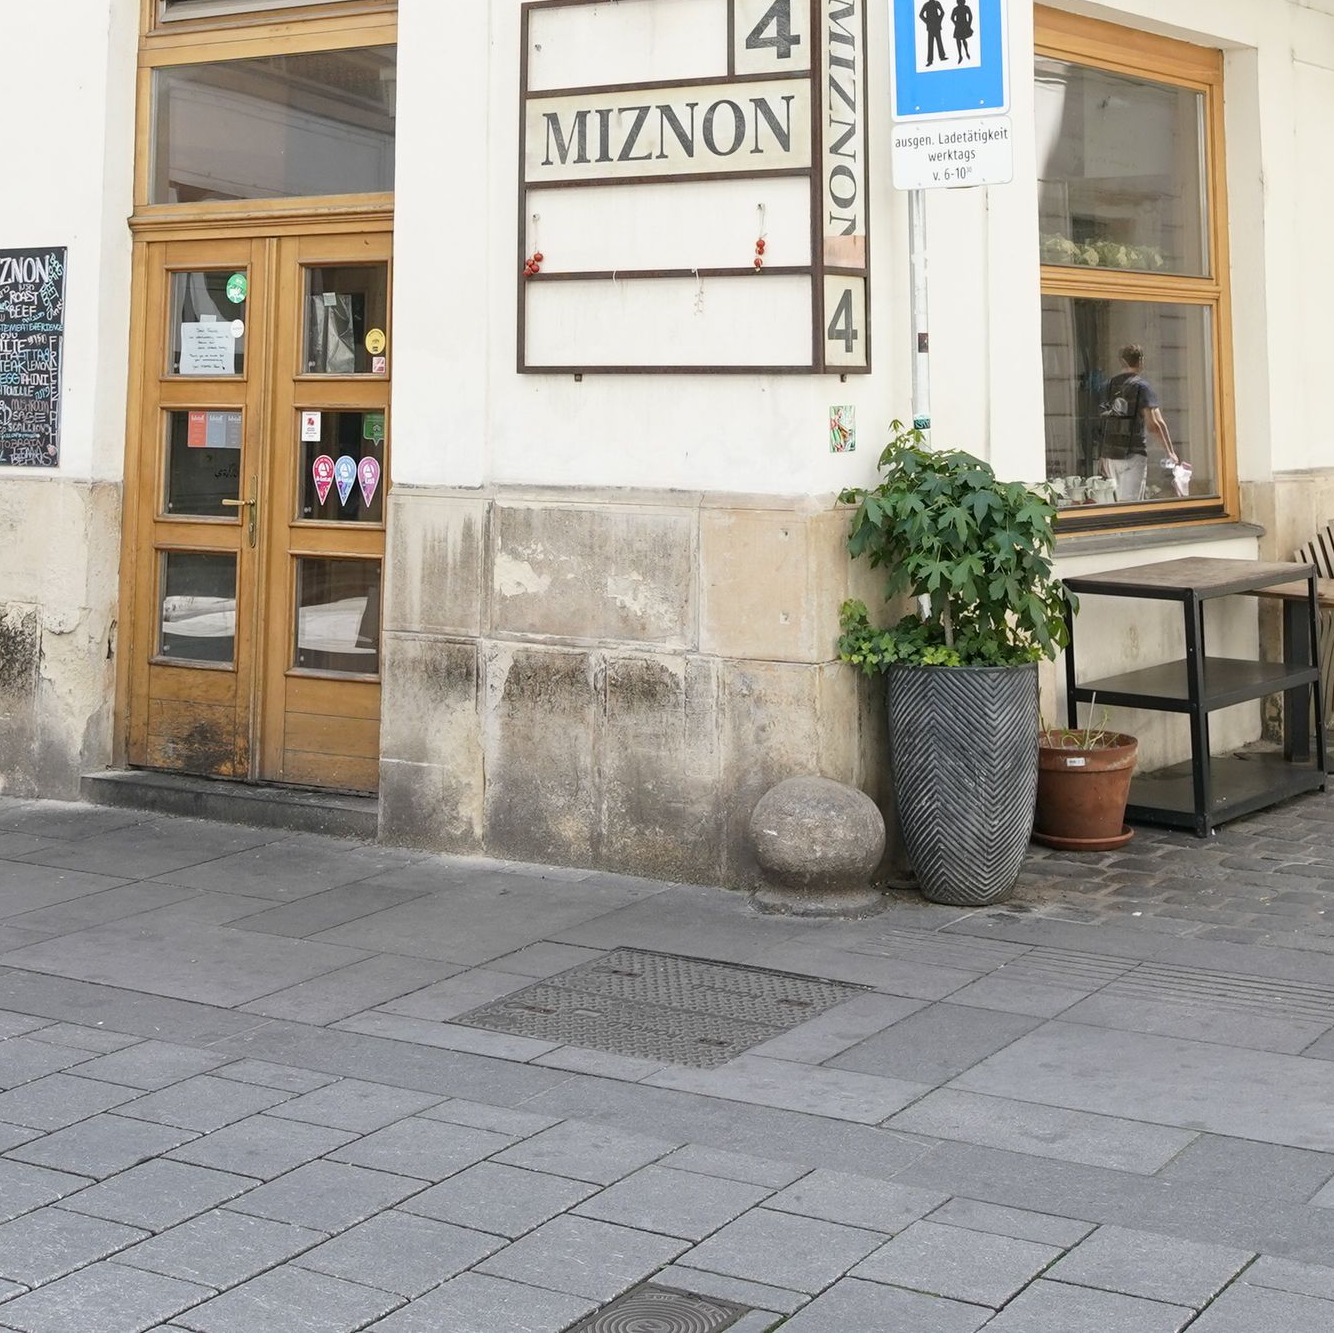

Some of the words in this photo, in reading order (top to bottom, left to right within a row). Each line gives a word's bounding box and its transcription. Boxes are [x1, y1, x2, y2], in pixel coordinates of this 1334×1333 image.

[541, 95, 795, 166] MIZNON
[895, 136, 935, 150] ausgen.
[938, 127, 1008, 145] Ladetätigkeit
[928, 149, 976, 162] werktags
[933, 171, 940, 181] v.
[9, 290, 39, 306] ROAST
[9, 304, 37, 319] BEEF
[827, 288, 858, 353] 4
